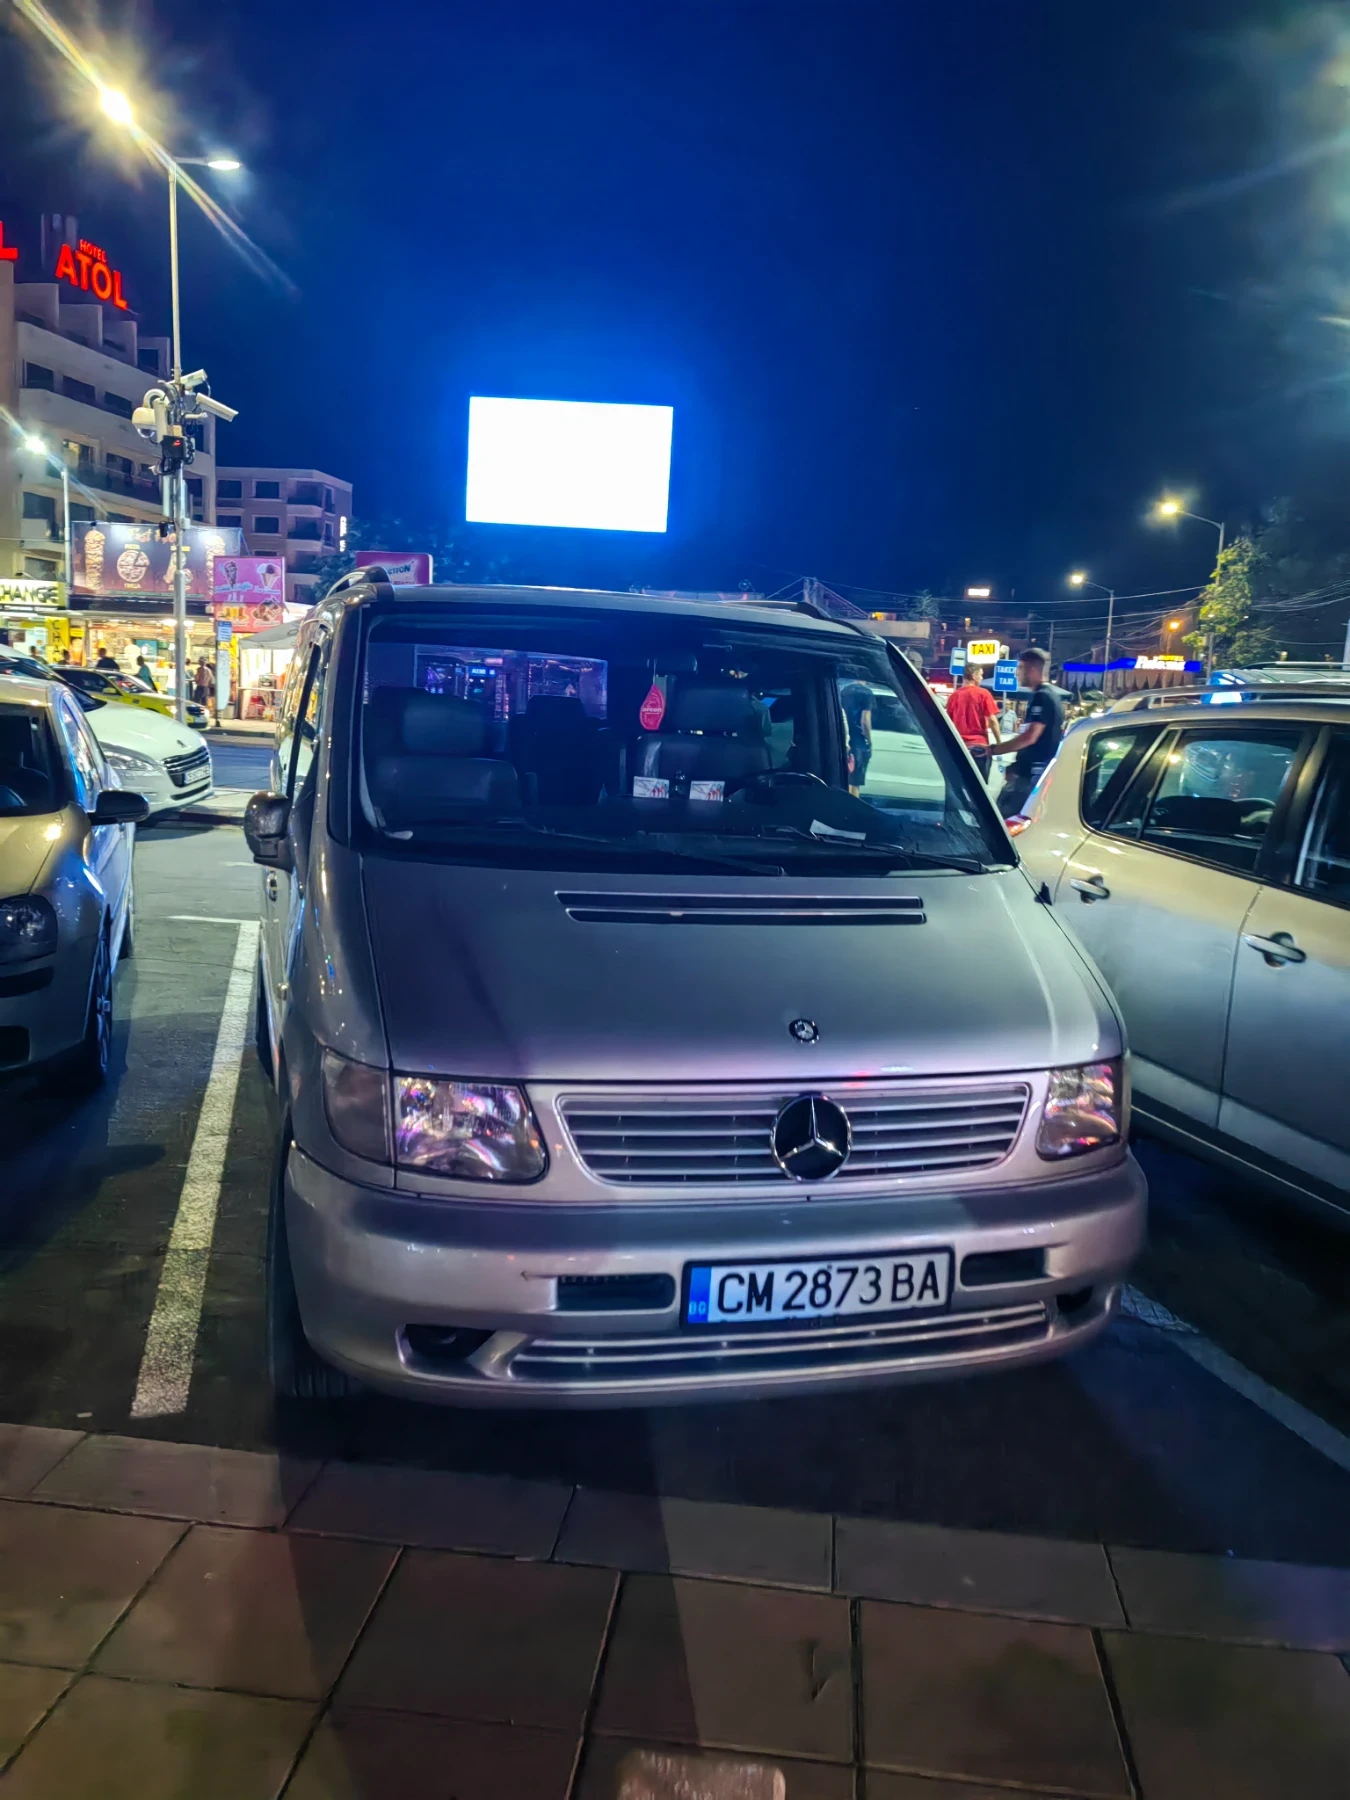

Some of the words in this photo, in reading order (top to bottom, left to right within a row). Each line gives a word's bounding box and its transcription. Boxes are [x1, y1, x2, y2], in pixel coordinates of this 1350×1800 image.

[79, 239, 107, 262] HOTEL
[55, 243, 127, 310] ATOL
[387, 564, 411, 575] CTION
[971, 643, 996, 655] TAXI
[717, 1272, 775, 1315] CM
[782, 1265, 882, 1312] 2873
[891, 1260, 940, 1303] BA
